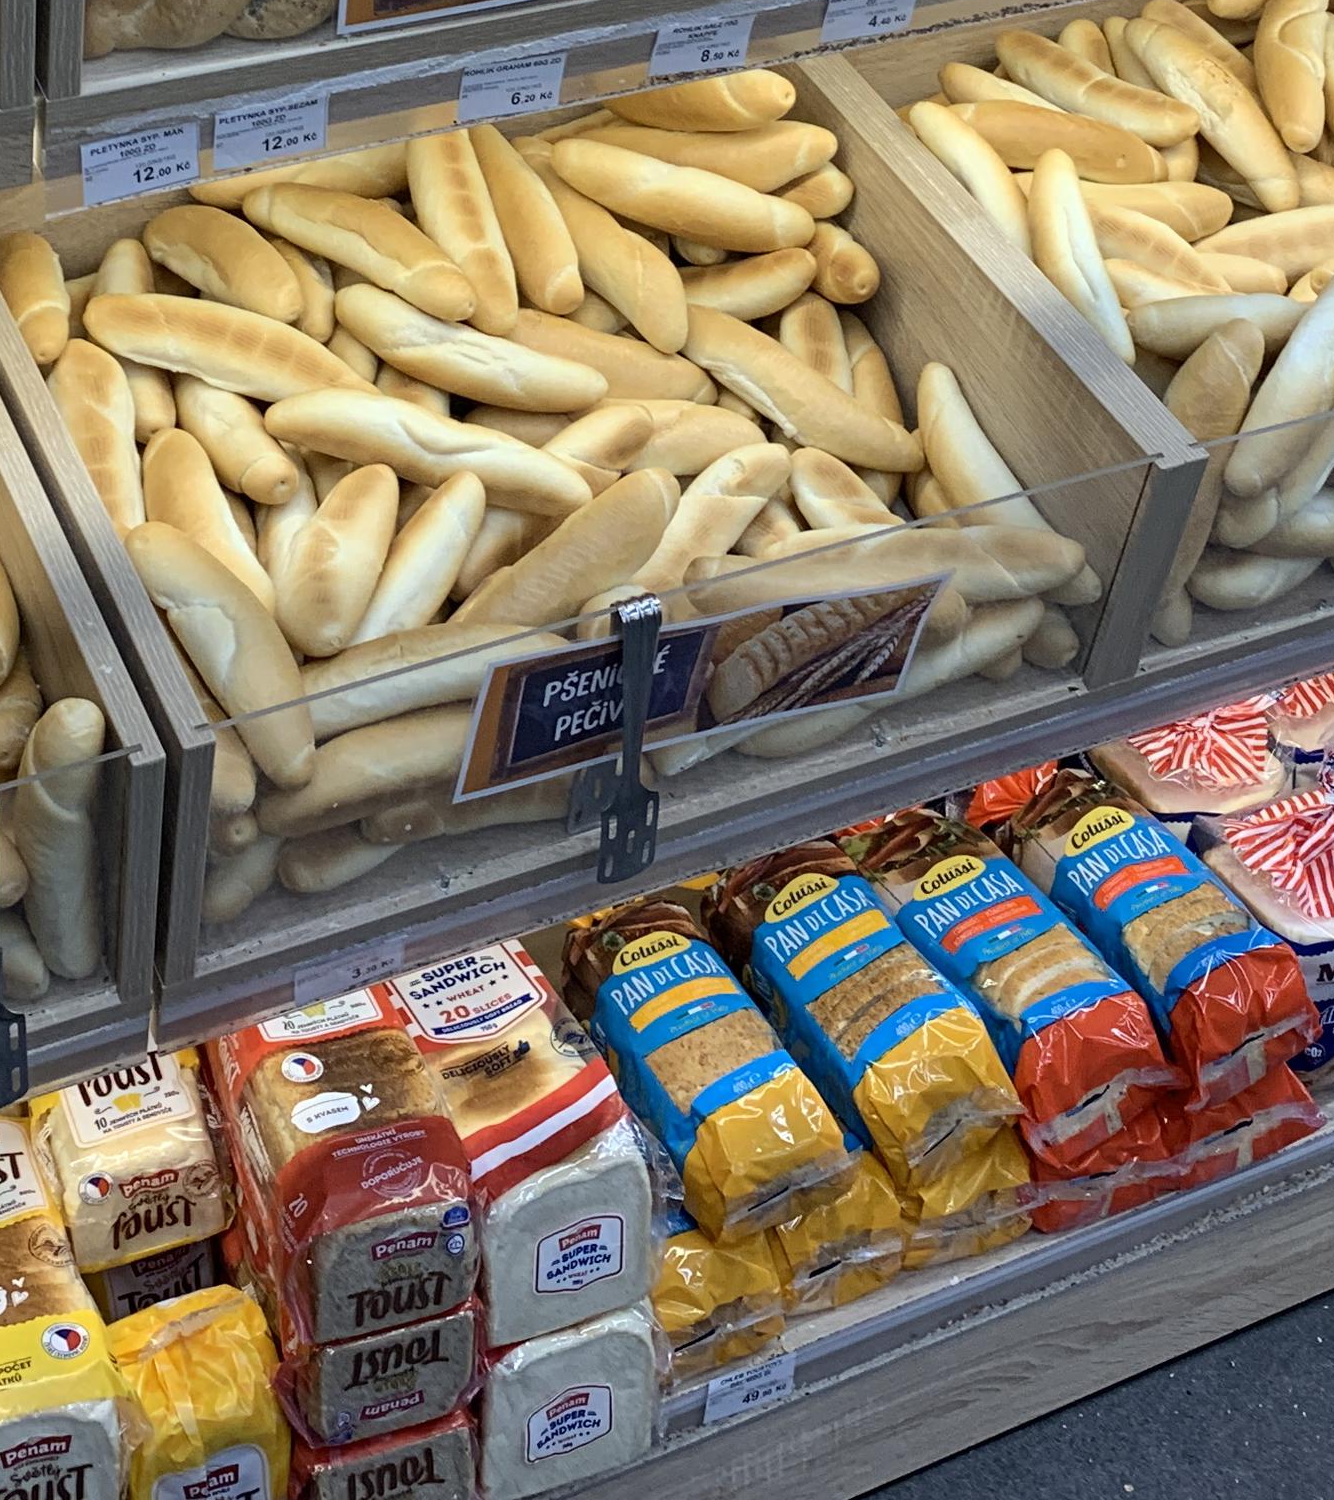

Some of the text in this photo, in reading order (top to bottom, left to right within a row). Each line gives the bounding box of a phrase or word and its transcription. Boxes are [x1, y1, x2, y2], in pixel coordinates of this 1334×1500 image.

[163, 127, 184, 138] MAK
[303, 131, 318, 142] Kč
[176, 161, 190, 172] Kč
[1071, 811, 1126, 850] Colussi
[1068, 851, 1113, 895] PAN
[1107, 842, 1126, 862] DI
[1122, 825, 1169, 858] CASA
[920, 859, 978, 895] Colussi
[773, 877, 828, 916] Colussi
[913, 899, 960, 939] PAN
[954, 891, 977, 910] DI
[972, 870, 1025, 902] CASA
[764, 887, 875, 964] PAN DI CASA
[620, 935, 682, 967] Colussi
[409, 961, 506, 1000] SANDWICH
[422, 956, 476, 982] SUPER
[610, 951, 725, 1015] PAN DI CASA
[446, 984, 485, 1003] WHEAT
[439, 993, 512, 1023] 20 SLICES
[283, 1021, 296, 1031] 20
[442, 1044, 511, 1080] DELICIOUSLY
[485, 1055, 513, 1076] SOFT
[94, 1117, 107, 1130] 10
[314, 1105, 349, 1121] KVASEM
[332, 1138, 391, 1158] TECHNOLOGIE
[123, 1173, 176, 1197] Penam
[362, 1156, 423, 1190] DOPORUČUJE
[113, 1198, 197, 1249] TOUST
[376, 1235, 432, 1257] Penam
[562, 1243, 598, 1263] SUPER
[547, 1254, 612, 1280] SANDWICH
[347, 1271, 452, 1327] TOUST
[344, 1329, 449, 1390] TOUST
[537, 1419, 601, 1449] SANDWICH
[549, 1410, 586, 1430] SUPER
[5, 1439, 67, 1466] Penam
